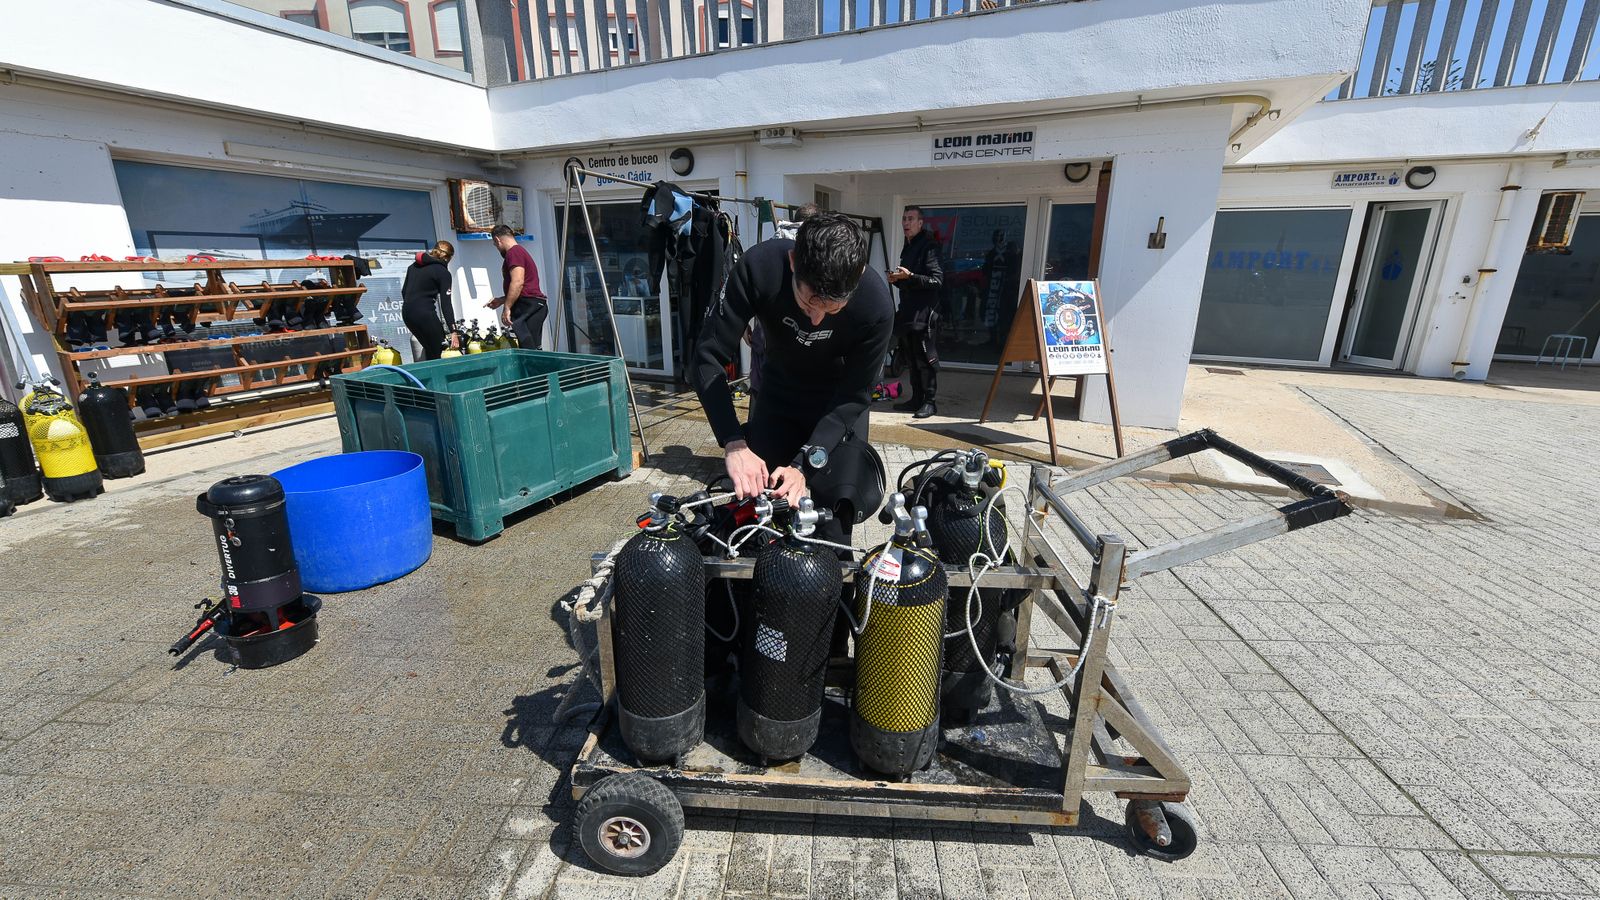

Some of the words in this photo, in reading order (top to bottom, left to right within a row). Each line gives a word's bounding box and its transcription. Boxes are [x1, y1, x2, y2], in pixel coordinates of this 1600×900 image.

[933, 150, 973, 161] DIVING
[975, 146, 1032, 158] CENTER
[588, 156, 616, 169] Centro
[619, 155, 629, 167] de
[631, 154, 659, 166] buceo
[627, 170, 653, 182] Cádiz
[1334, 172, 1377, 183] AMPORT
[1211, 249, 1311, 271] AMPORT
[782, 316, 833, 341] CRESSI
[220, 535, 236, 579] DIVERTUG
